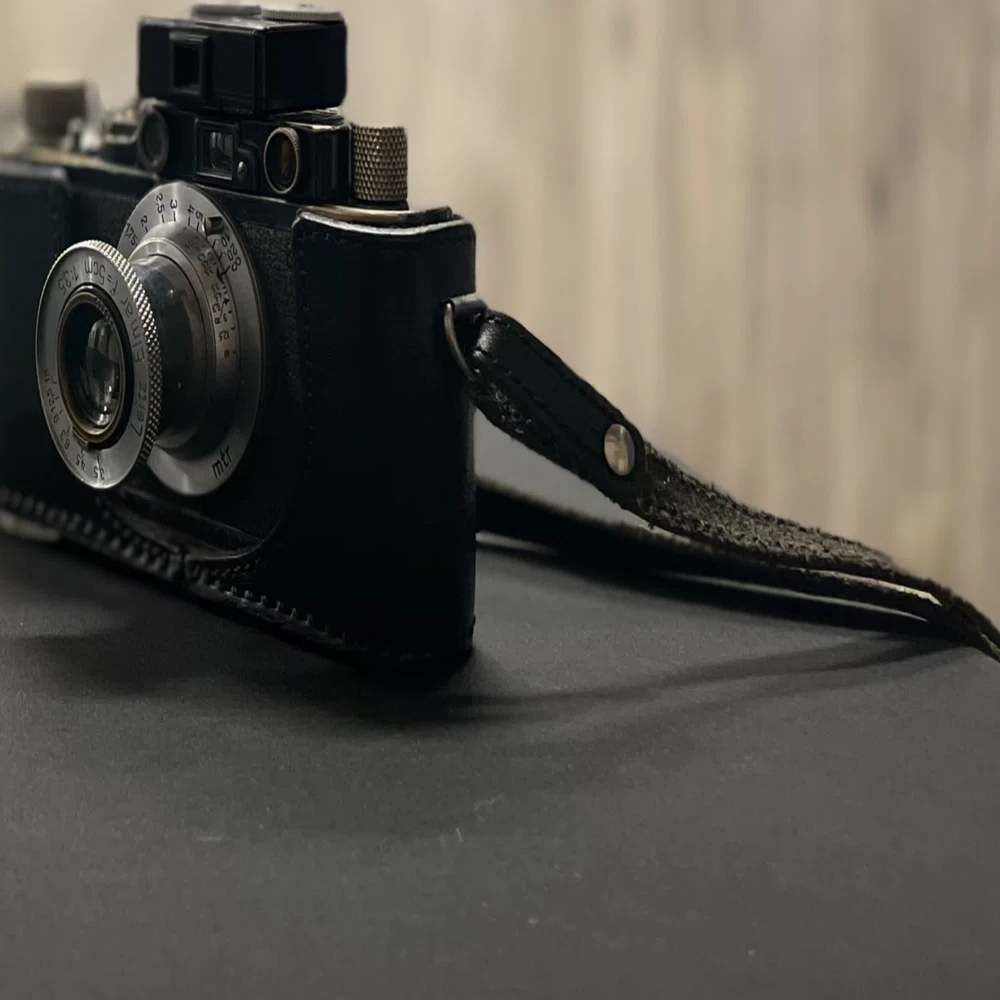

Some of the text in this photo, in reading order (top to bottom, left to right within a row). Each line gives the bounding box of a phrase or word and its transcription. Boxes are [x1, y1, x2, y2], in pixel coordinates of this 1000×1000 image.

[141, 215, 148, 227] 2
[170, 199, 178, 210] 3
[187, 204, 196, 214] 4
[196, 210, 203, 221] 5
[221, 232, 230, 248] 10
[227, 243, 238, 261] 20
[121, 298, 146, 363] Elmar
[212, 445, 232, 479] mtr
